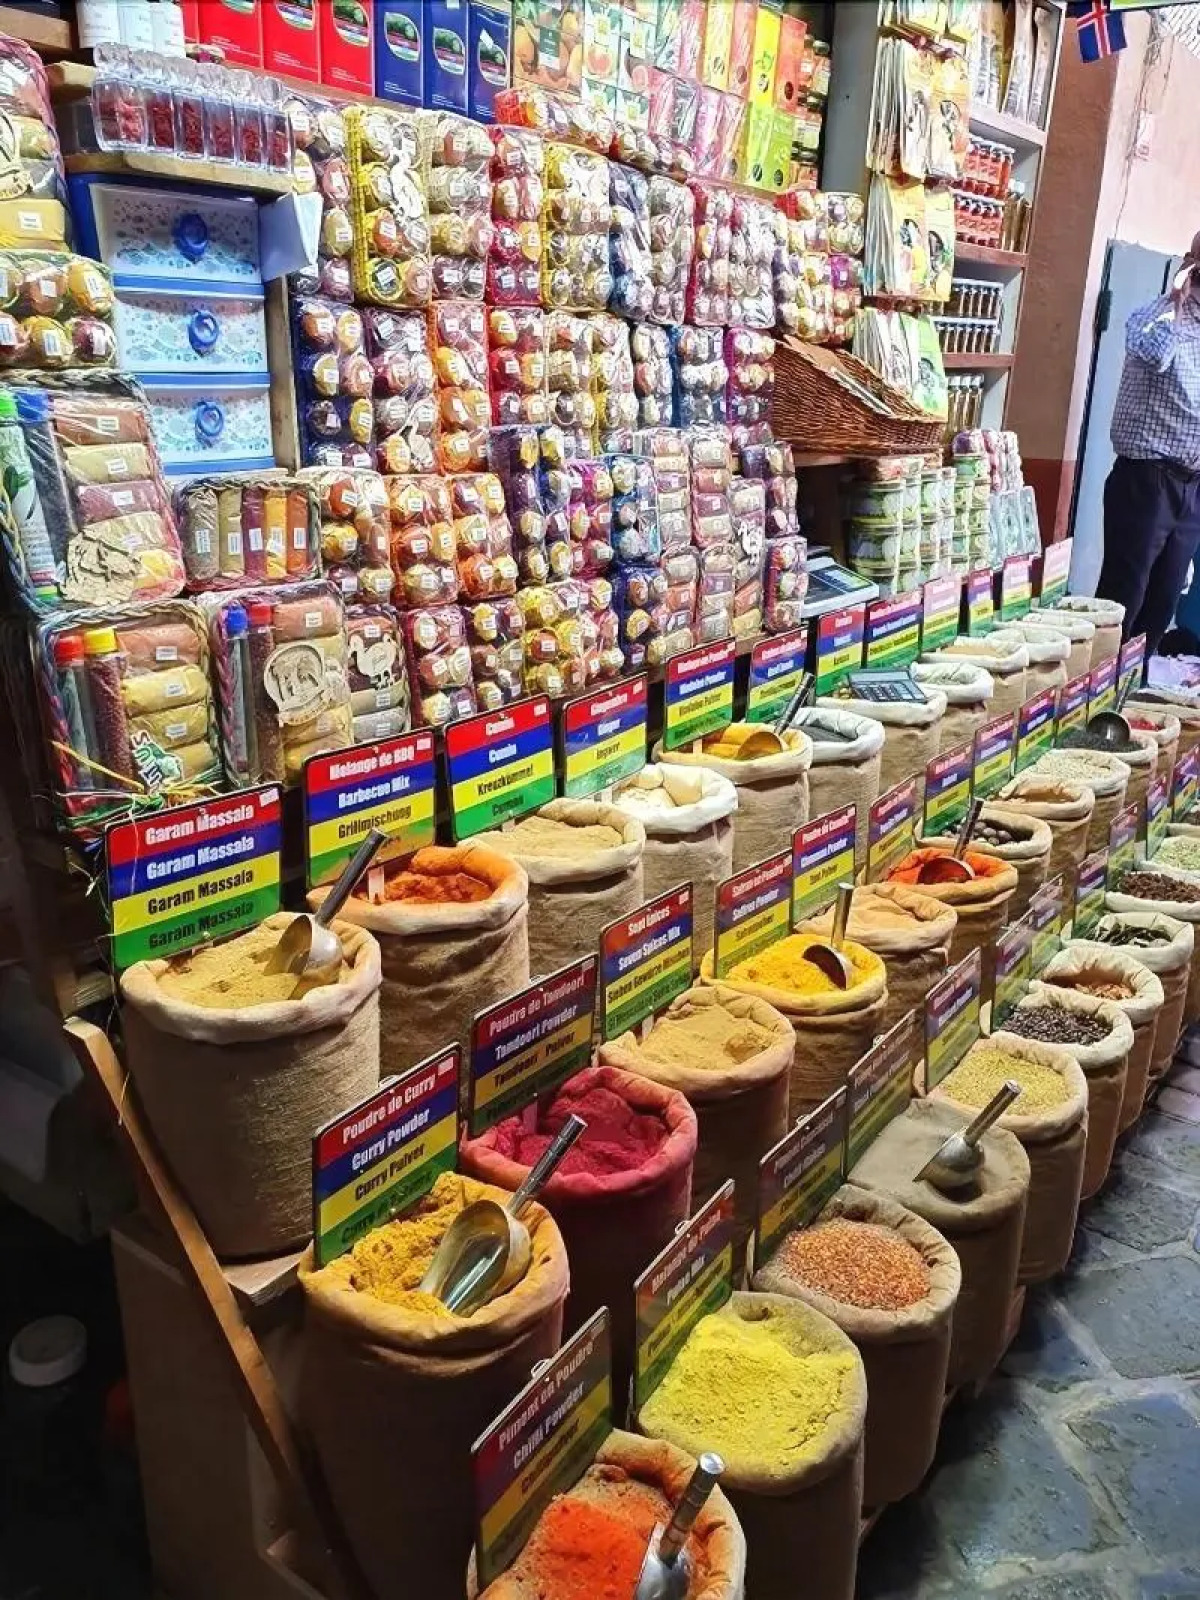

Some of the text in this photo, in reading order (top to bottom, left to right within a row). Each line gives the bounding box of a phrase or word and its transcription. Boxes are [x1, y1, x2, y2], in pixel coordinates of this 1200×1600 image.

[338, 782, 391, 809] Barbecue
[145, 804, 255, 845] Garam Massala
[338, 805, 412, 839] Grillmischung
[147, 836, 255, 880] Garam Massala
[148, 870, 254, 915] Garam Massala
[149, 902, 254, 948] Garam Massala
[342, 1074, 436, 1145] Poudre de Curry
[352, 1108, 431, 1171] Curry Powder
[355, 1143, 425, 1200] Curry Pulver
[499, 1399, 540, 1450] Piment
[556, 1341, 593, 1385] Poudre
[545, 1380, 585, 1436] Powder
